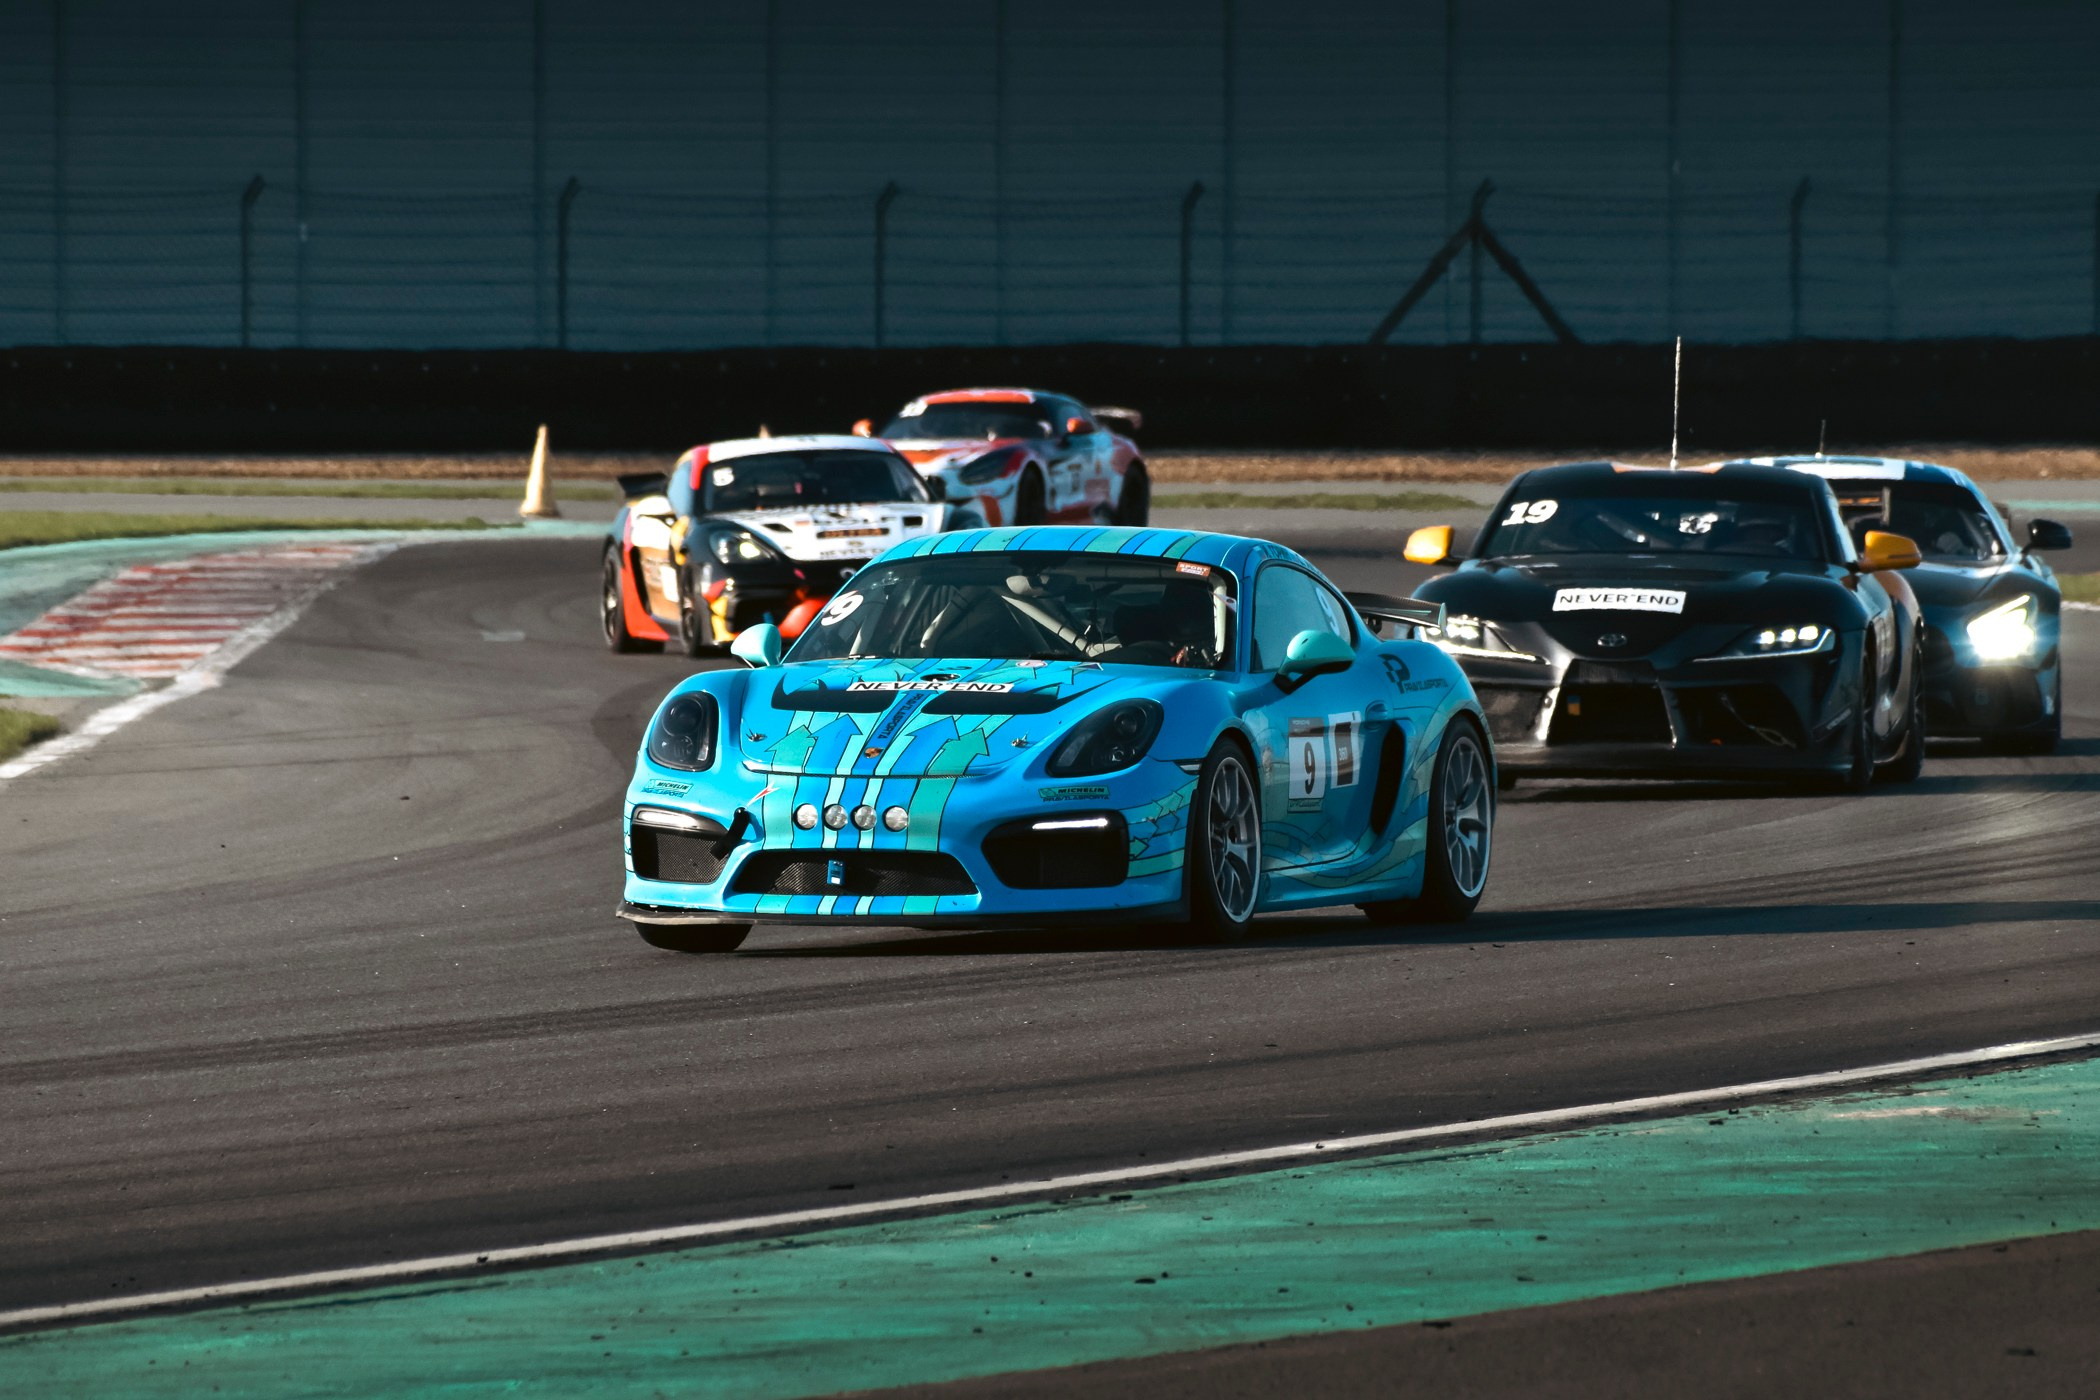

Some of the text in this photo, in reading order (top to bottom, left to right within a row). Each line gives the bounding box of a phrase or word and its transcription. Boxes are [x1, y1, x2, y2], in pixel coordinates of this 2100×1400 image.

[1501, 499, 1559, 526] 19
[1559, 593, 1679, 606] NEVER END
[853, 682, 1006, 692] NEVER END
[1304, 742, 1316, 795] 9
[656, 781, 690, 790] MICHELIN
